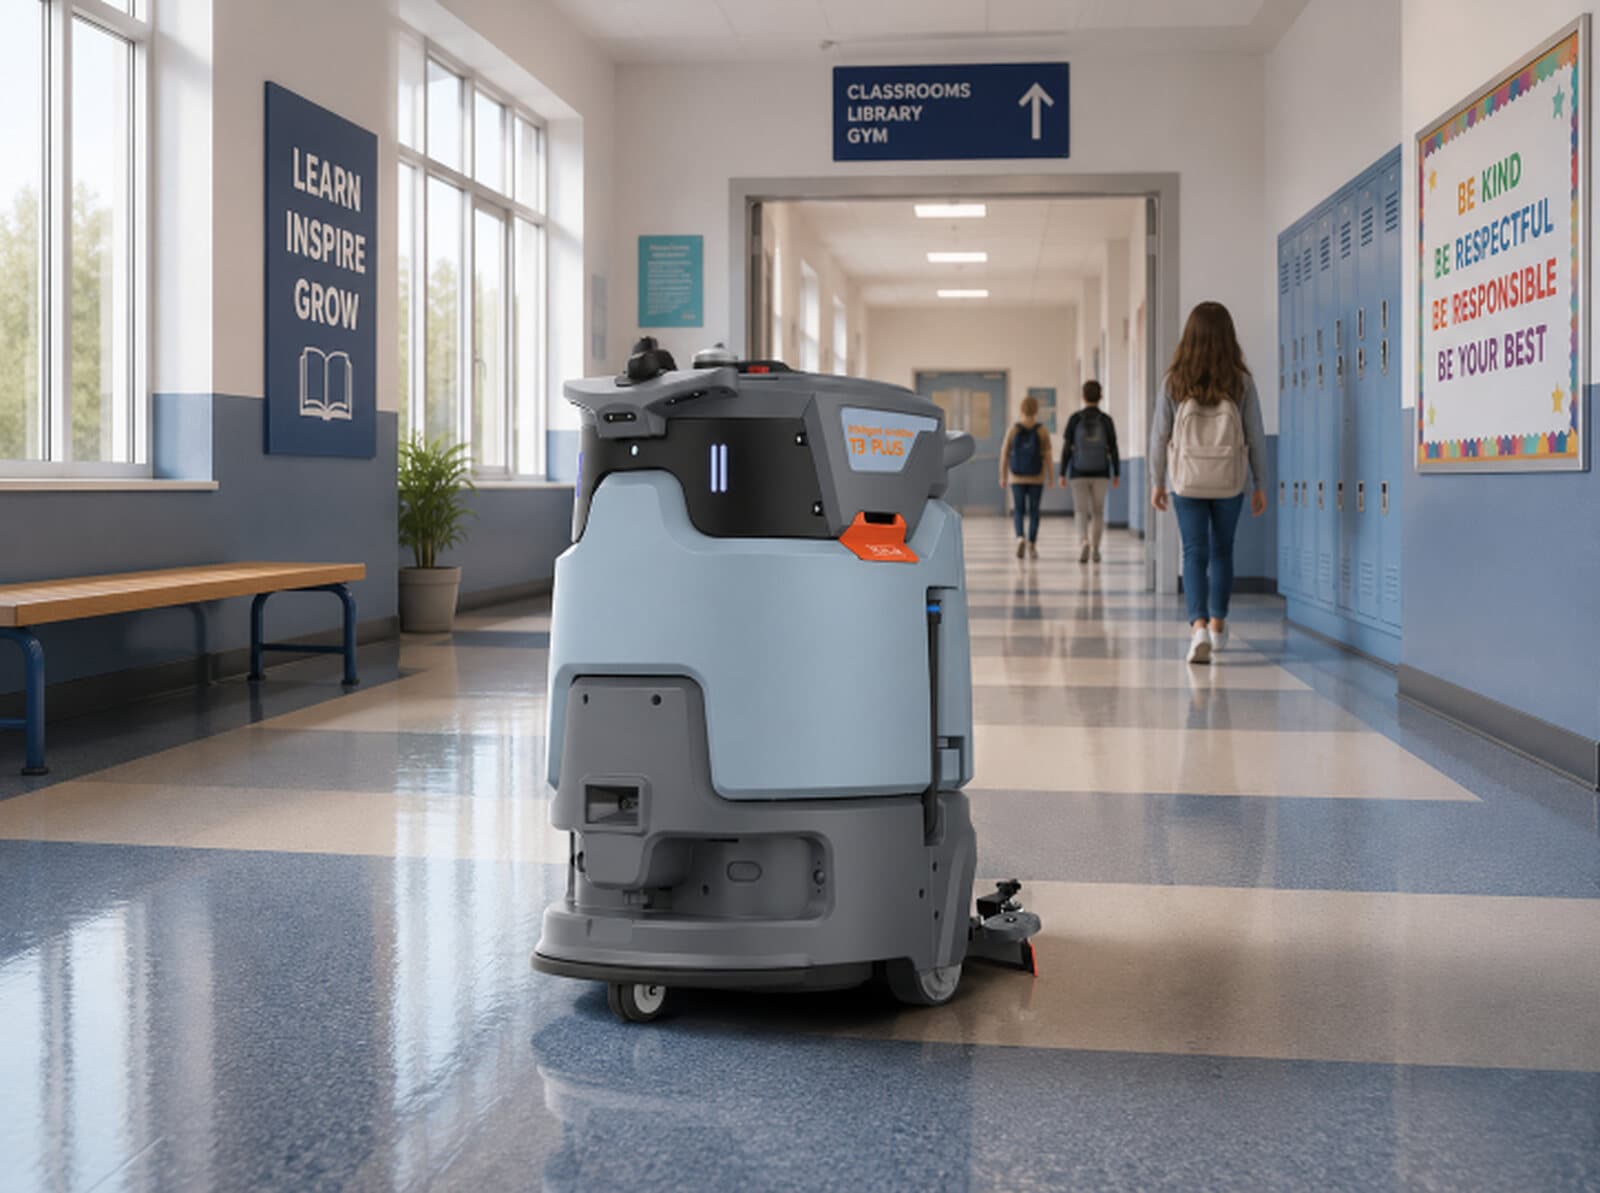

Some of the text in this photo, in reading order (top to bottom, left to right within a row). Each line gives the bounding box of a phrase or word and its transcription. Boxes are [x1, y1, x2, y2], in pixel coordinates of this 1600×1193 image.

[847, 82, 971, 100] CLASSROOMS
[847, 105, 923, 122] LIBRARY
[847, 127, 888, 143] GYM
[293, 146, 361, 212] LEARN
[1457, 152, 1522, 216] BE KIND
[286, 210, 366, 274] INSPIRE
[1434, 197, 1554, 279] BE RESPECTFUL
[294, 278, 359, 331] GROW
[1432, 257, 1557, 331] BE RESPONSIBLE
[1438, 324, 1547, 382] BE YOUR BEST
[848, 437, 904, 456] T3 PLUS
